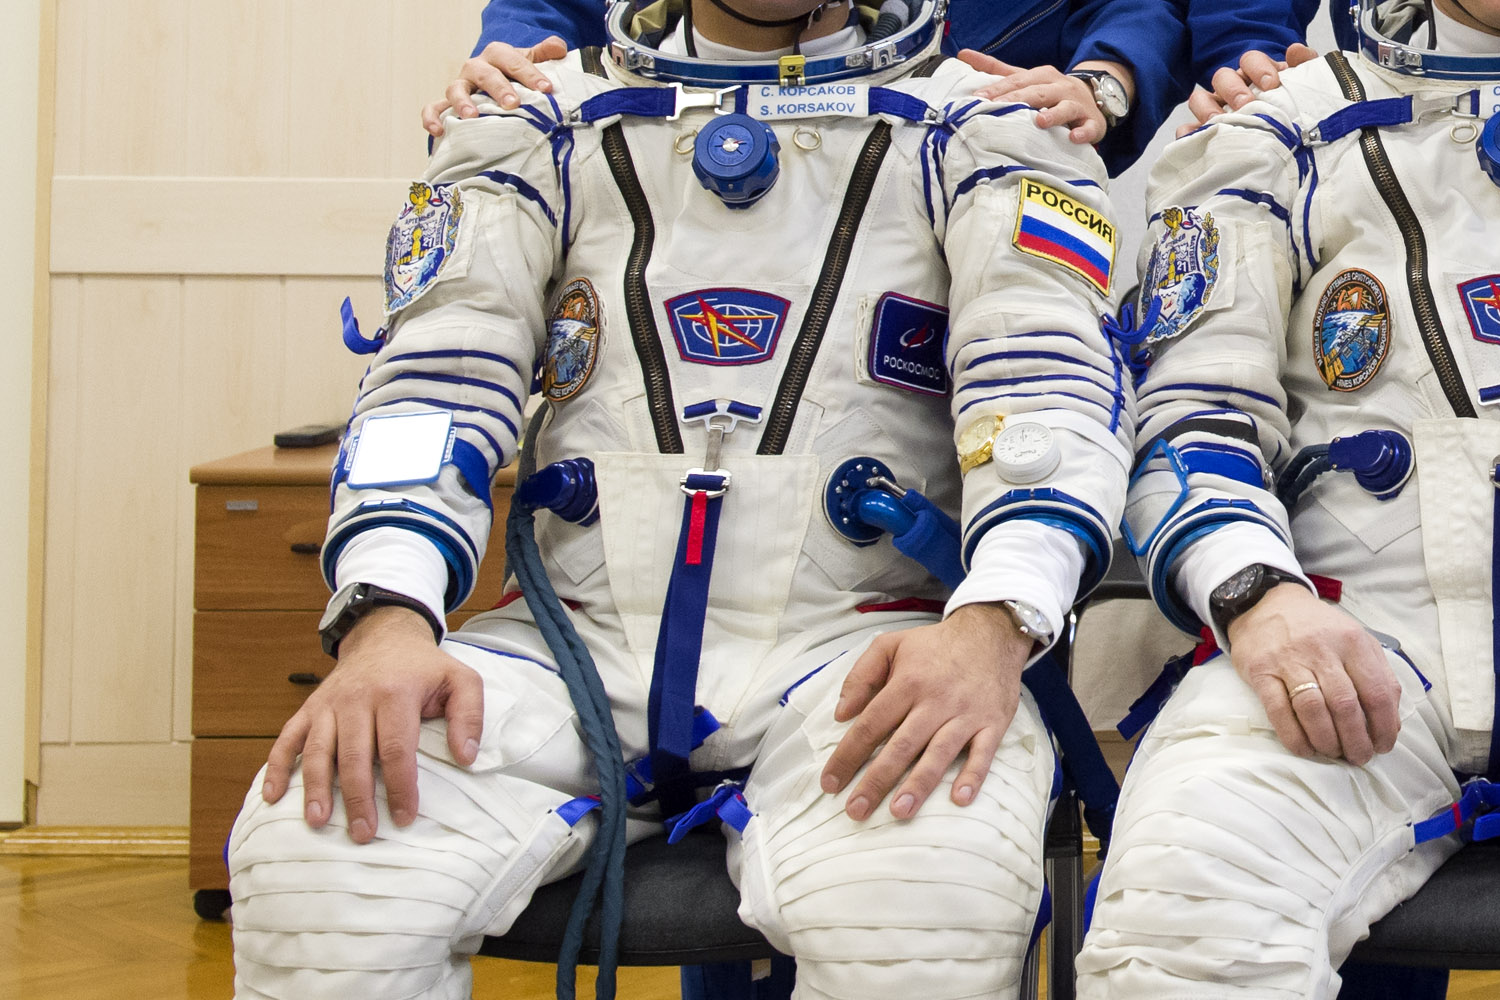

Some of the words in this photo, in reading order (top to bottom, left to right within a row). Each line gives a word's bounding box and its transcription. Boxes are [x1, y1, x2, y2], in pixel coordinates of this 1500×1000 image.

[761, 86, 773, 97] С.
[778, 85, 856, 97] КОРСАКОВ
[760, 105, 773, 116] S.
[777, 102, 856, 115] KORSAKOV
[1026, 183, 1113, 243] РОССИЯ
[1176, 260, 1187, 273] 21
[883, 355, 940, 380] РОСКОСМОС
